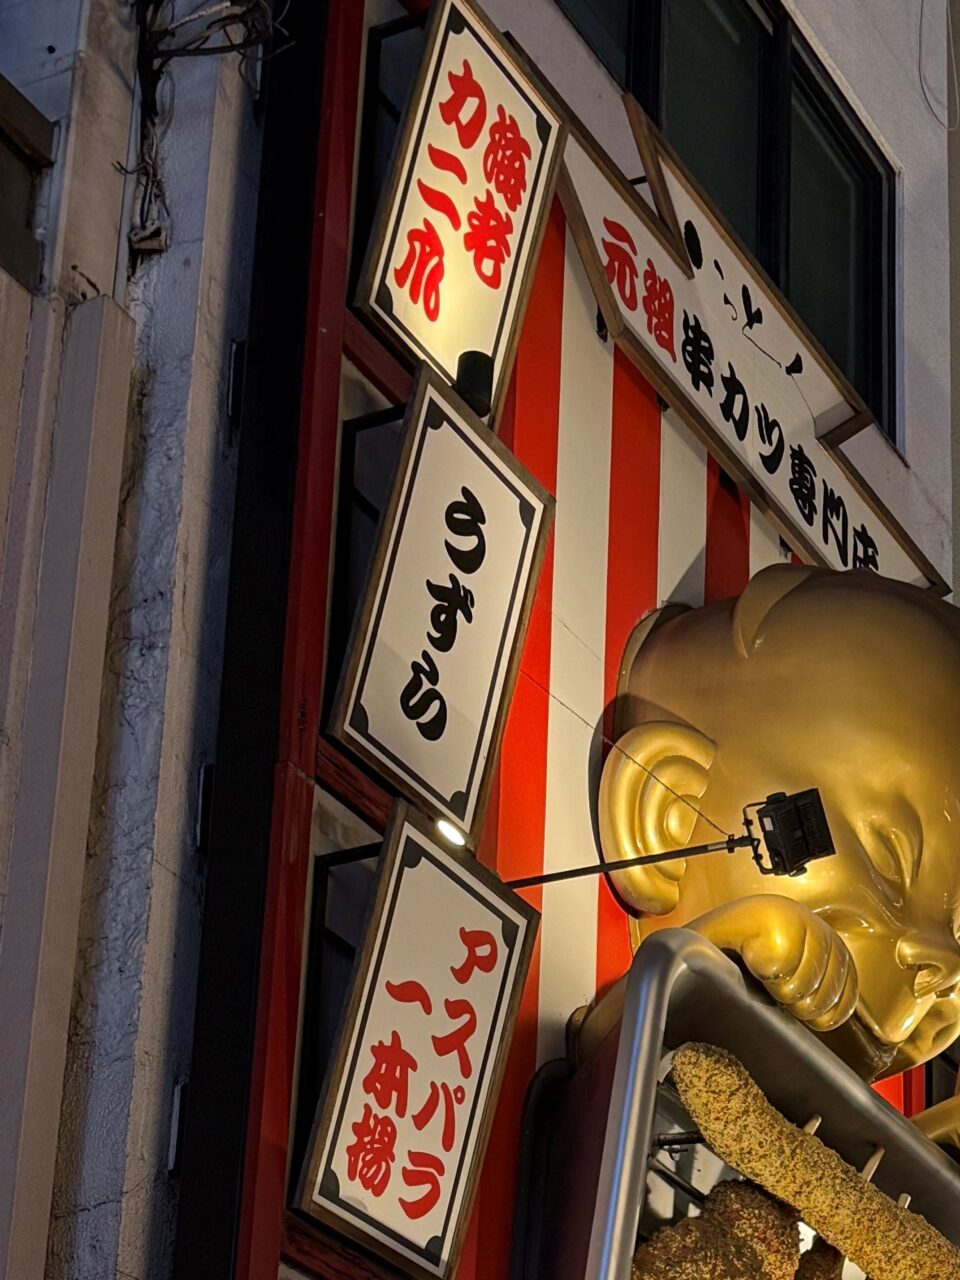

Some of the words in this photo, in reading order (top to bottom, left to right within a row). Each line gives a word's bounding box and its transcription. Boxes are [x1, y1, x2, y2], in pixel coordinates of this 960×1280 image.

[394, 59, 487, 322] カニ爪
[400, 486, 486, 741] うずら
[399, 926, 498, 1220] アスパラ
